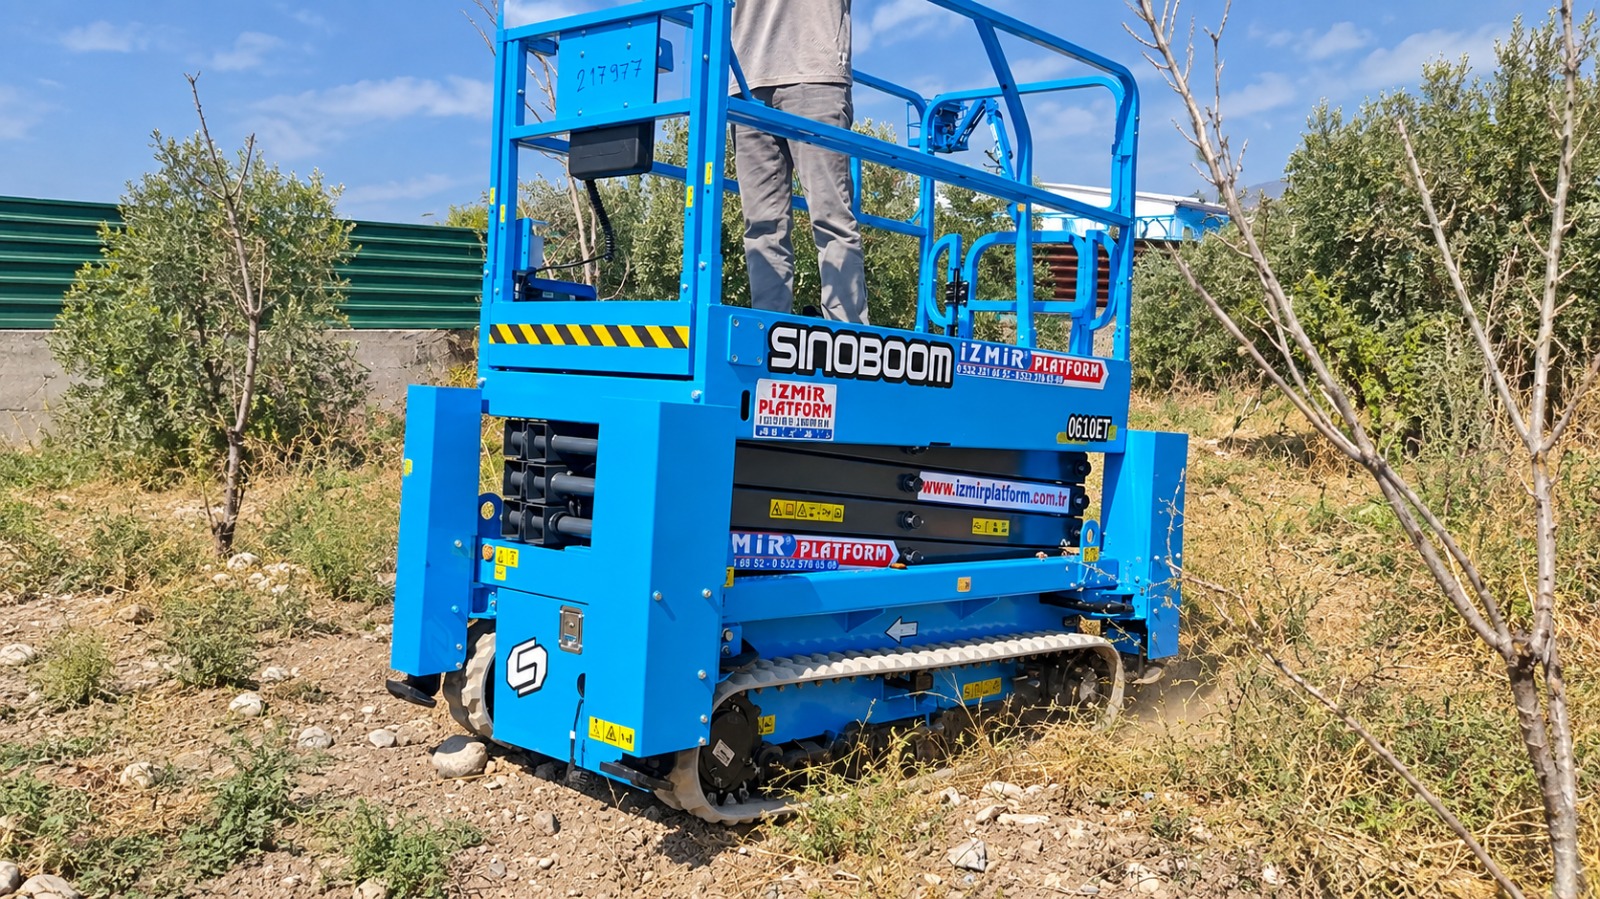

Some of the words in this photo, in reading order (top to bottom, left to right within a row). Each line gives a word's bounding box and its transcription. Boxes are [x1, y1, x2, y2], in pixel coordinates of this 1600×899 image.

[577, 59, 642, 92] 217977
[770, 326, 952, 384] SINOBOOM
[1034, 356, 1100, 378] PLATFORM
[759, 399, 832, 418] PLATFORM
[1067, 416, 1111, 440] 0610ET
[922, 478, 1067, 507] www.izmirplatform.com.tr
[800, 541, 887, 561] PLATFORM
